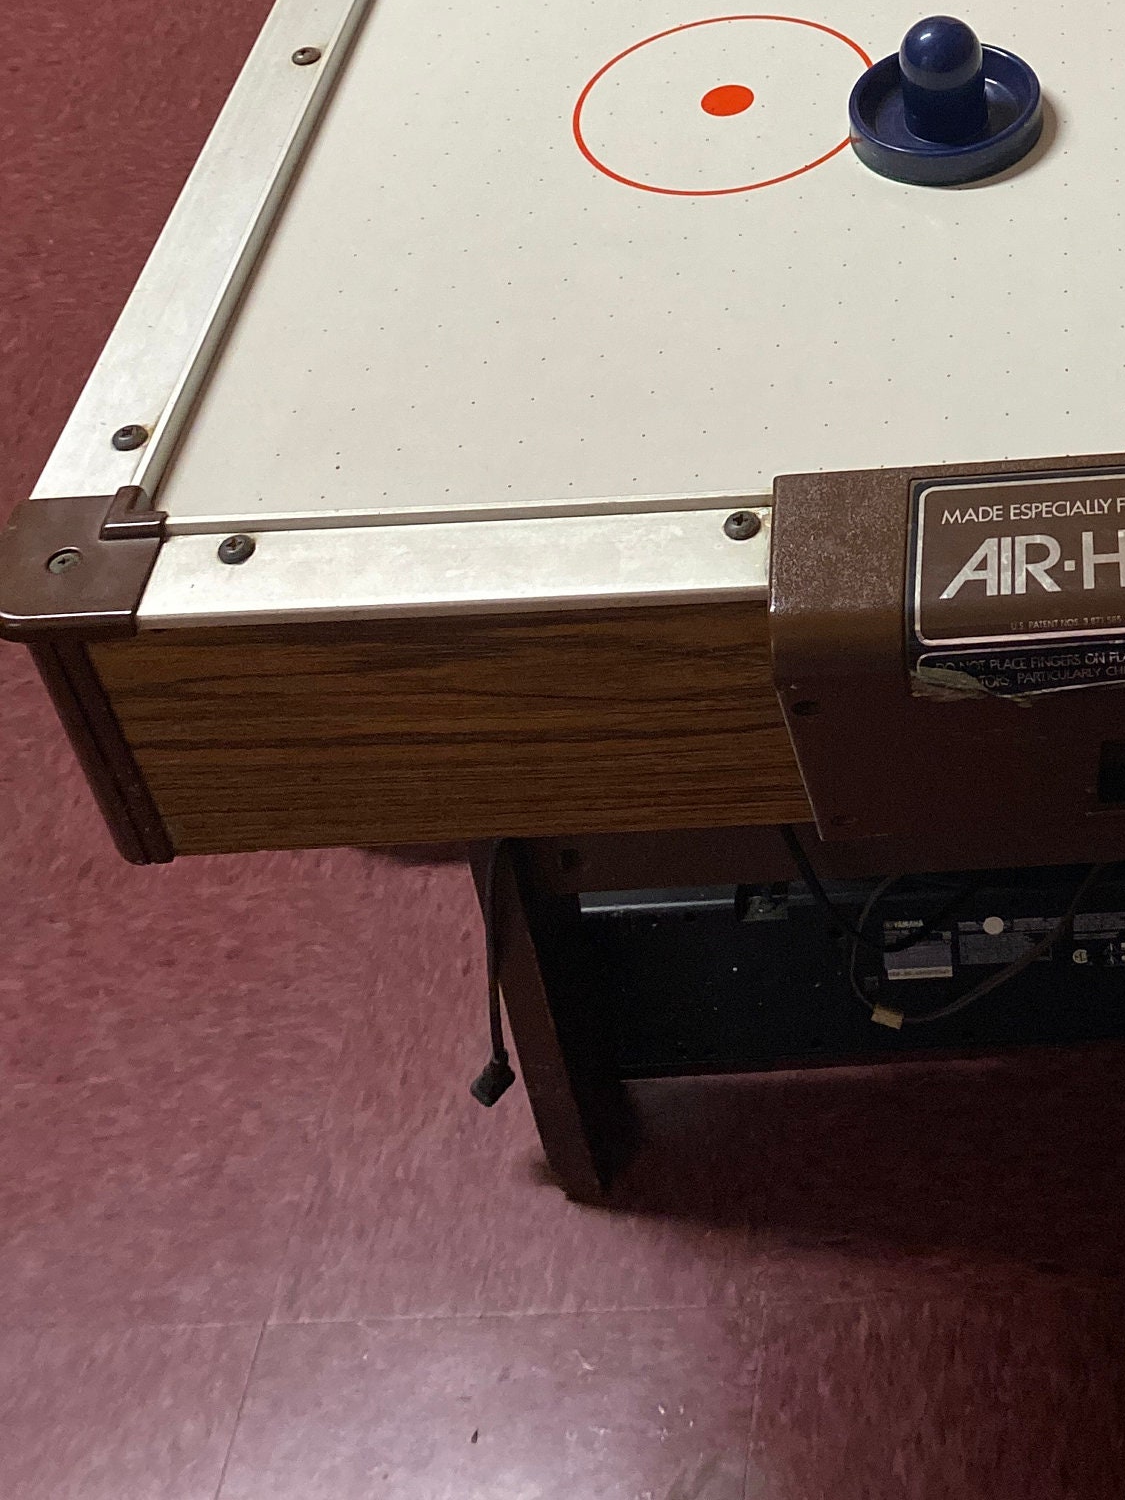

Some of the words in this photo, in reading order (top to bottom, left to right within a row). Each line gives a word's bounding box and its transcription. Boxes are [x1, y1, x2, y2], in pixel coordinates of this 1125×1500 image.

[941, 506, 1003, 524] MADE
[1010, 498, 1112, 520] ESPECIALLY
[1028, 619, 1058, 629] PATENT
[989, 658, 1027, 669] PLACE
[1031, 654, 1081, 668] FINGERS
[1085, 652, 1105, 664] ON
[1017, 666, 1101, 684] PARTICULARLY
